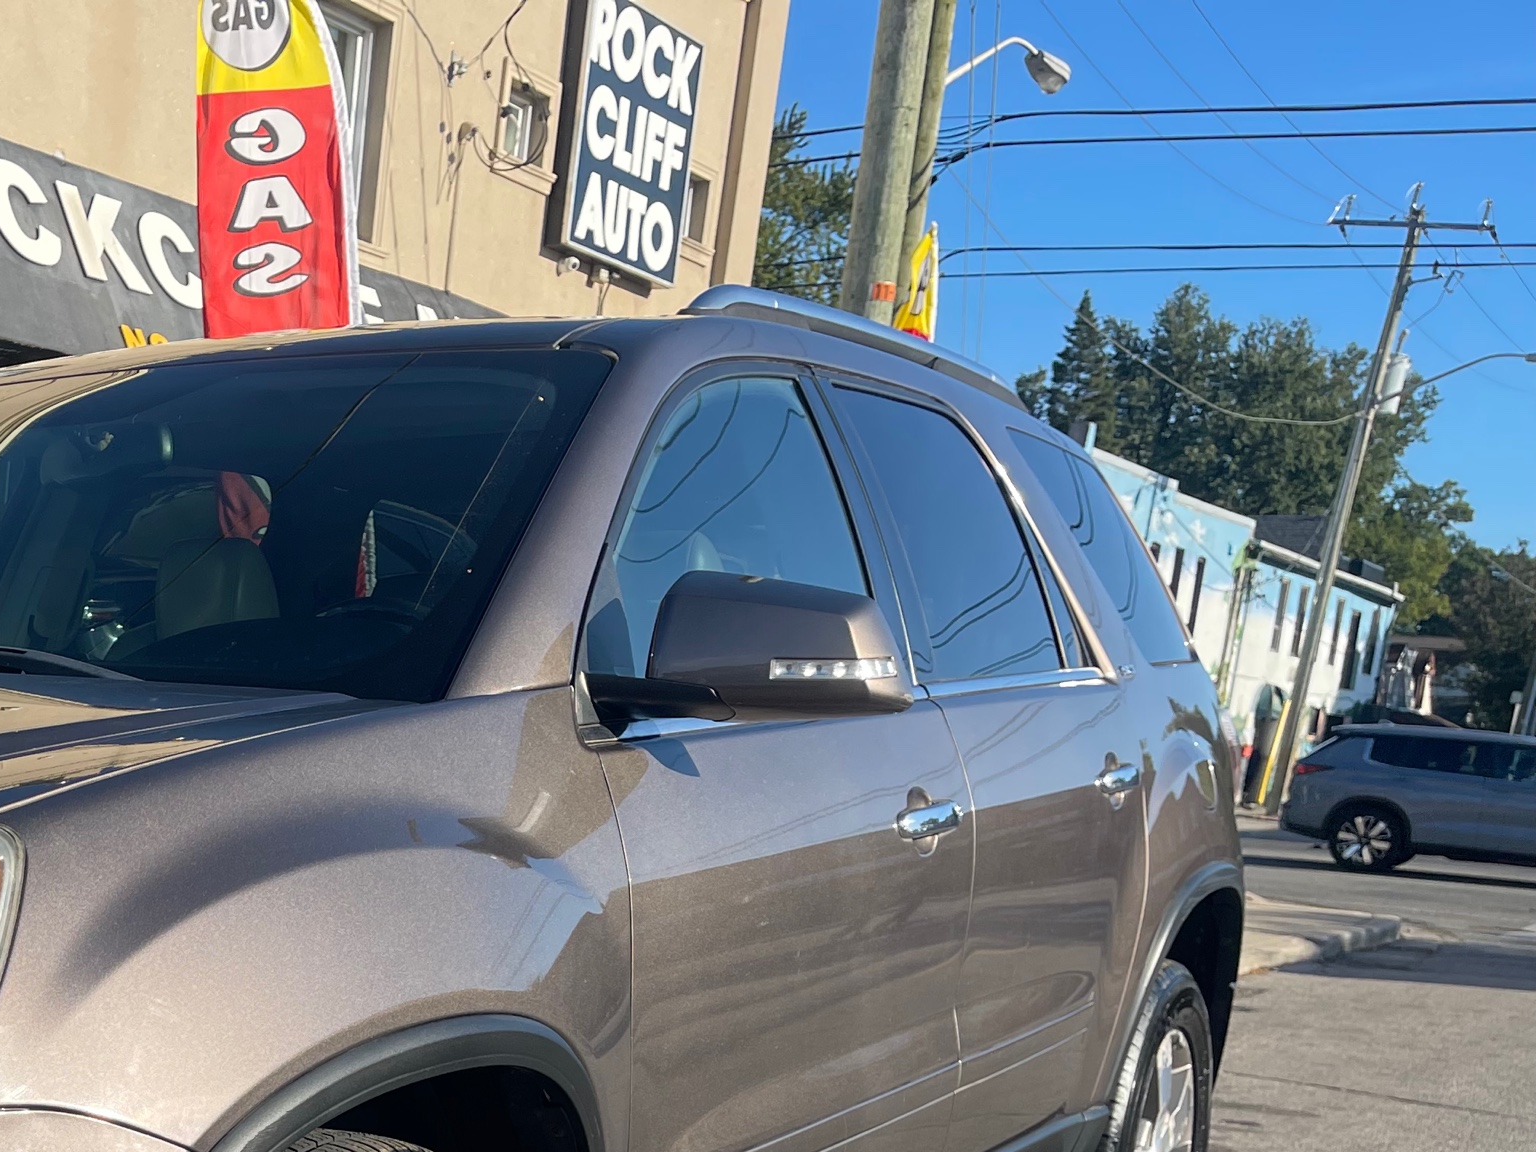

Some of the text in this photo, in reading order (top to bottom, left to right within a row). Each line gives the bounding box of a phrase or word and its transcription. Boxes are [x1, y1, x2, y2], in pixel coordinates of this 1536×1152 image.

[590, 0, 701, 116] ROCK
[586, 85, 687, 191] CLIFF
[574, 171, 674, 272] AUTO
